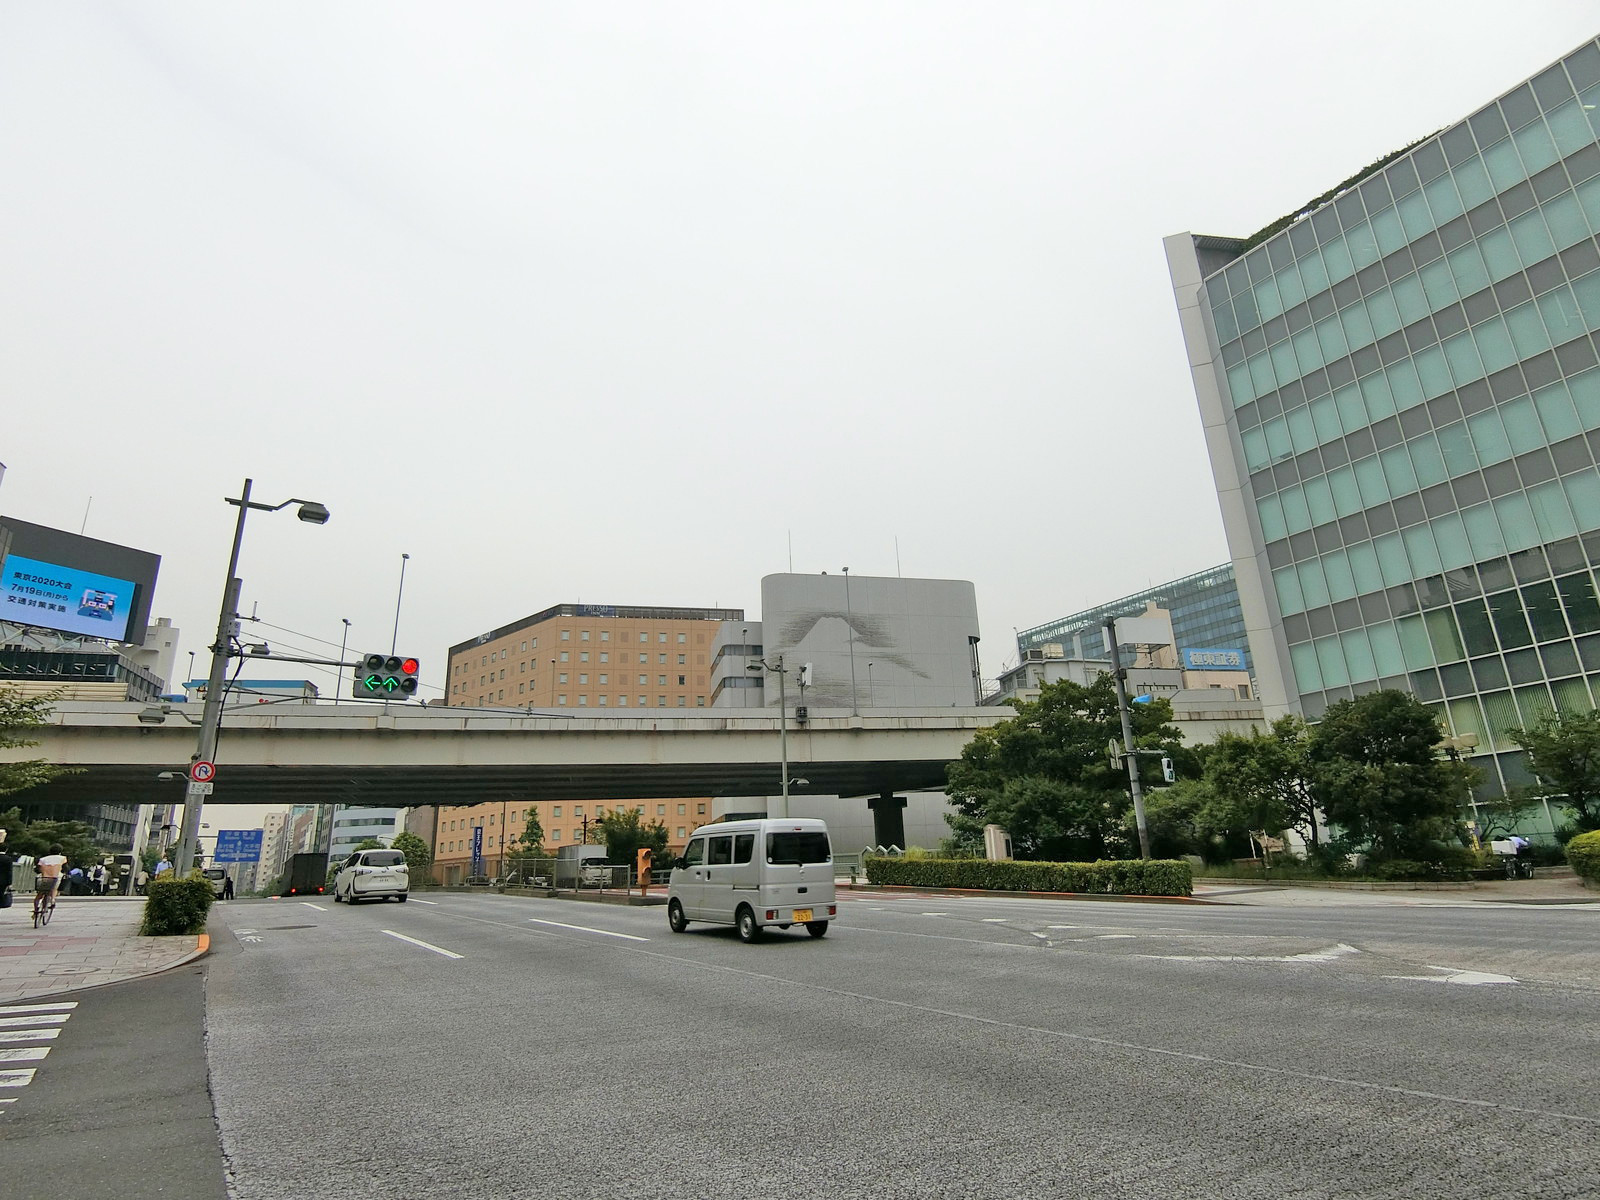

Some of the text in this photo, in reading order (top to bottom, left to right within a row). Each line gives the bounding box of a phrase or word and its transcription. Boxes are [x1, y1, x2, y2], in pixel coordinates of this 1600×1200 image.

[13, 572, 72, 589] 東京2020大会
[11, 583, 68, 601] 7月19日(月)から
[7, 595, 66, 612] 交通対策実施
[1190, 651, 1240, 665] 極東証券
